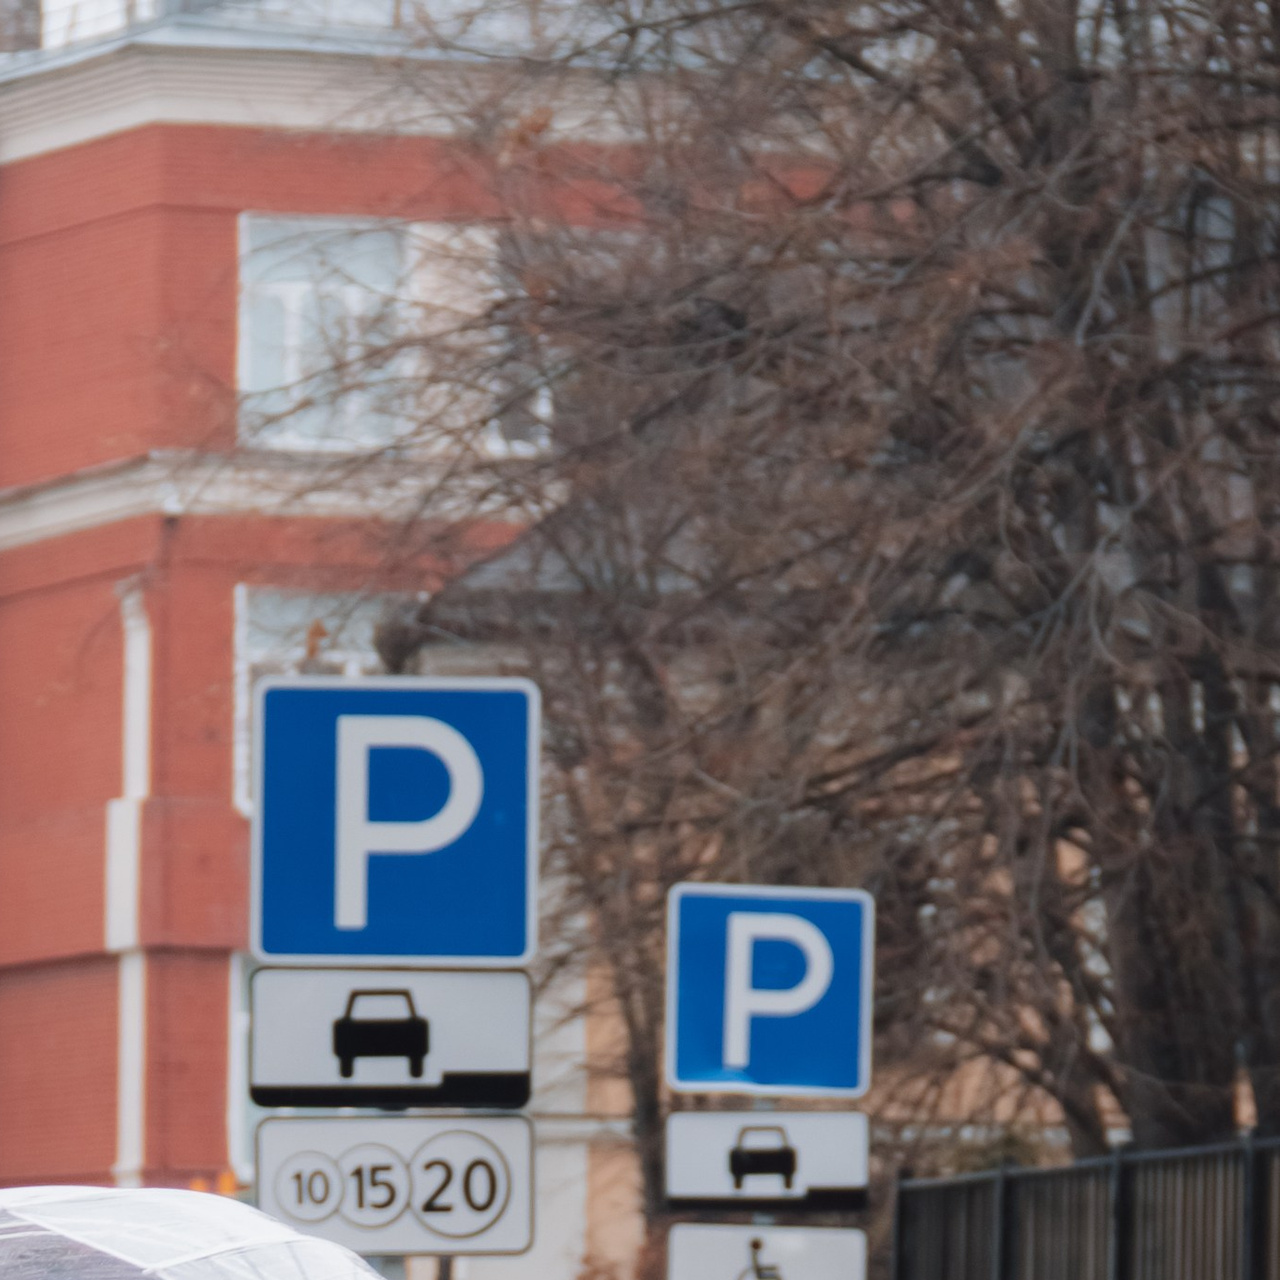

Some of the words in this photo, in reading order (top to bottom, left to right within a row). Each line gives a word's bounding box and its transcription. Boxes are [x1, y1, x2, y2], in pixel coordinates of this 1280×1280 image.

[333, 714, 485, 931] P
[723, 911, 834, 1069] P
[291, 1169, 329, 1204] 10
[350, 1165, 396, 1209] 15
[422, 1158, 497, 1212] 20
